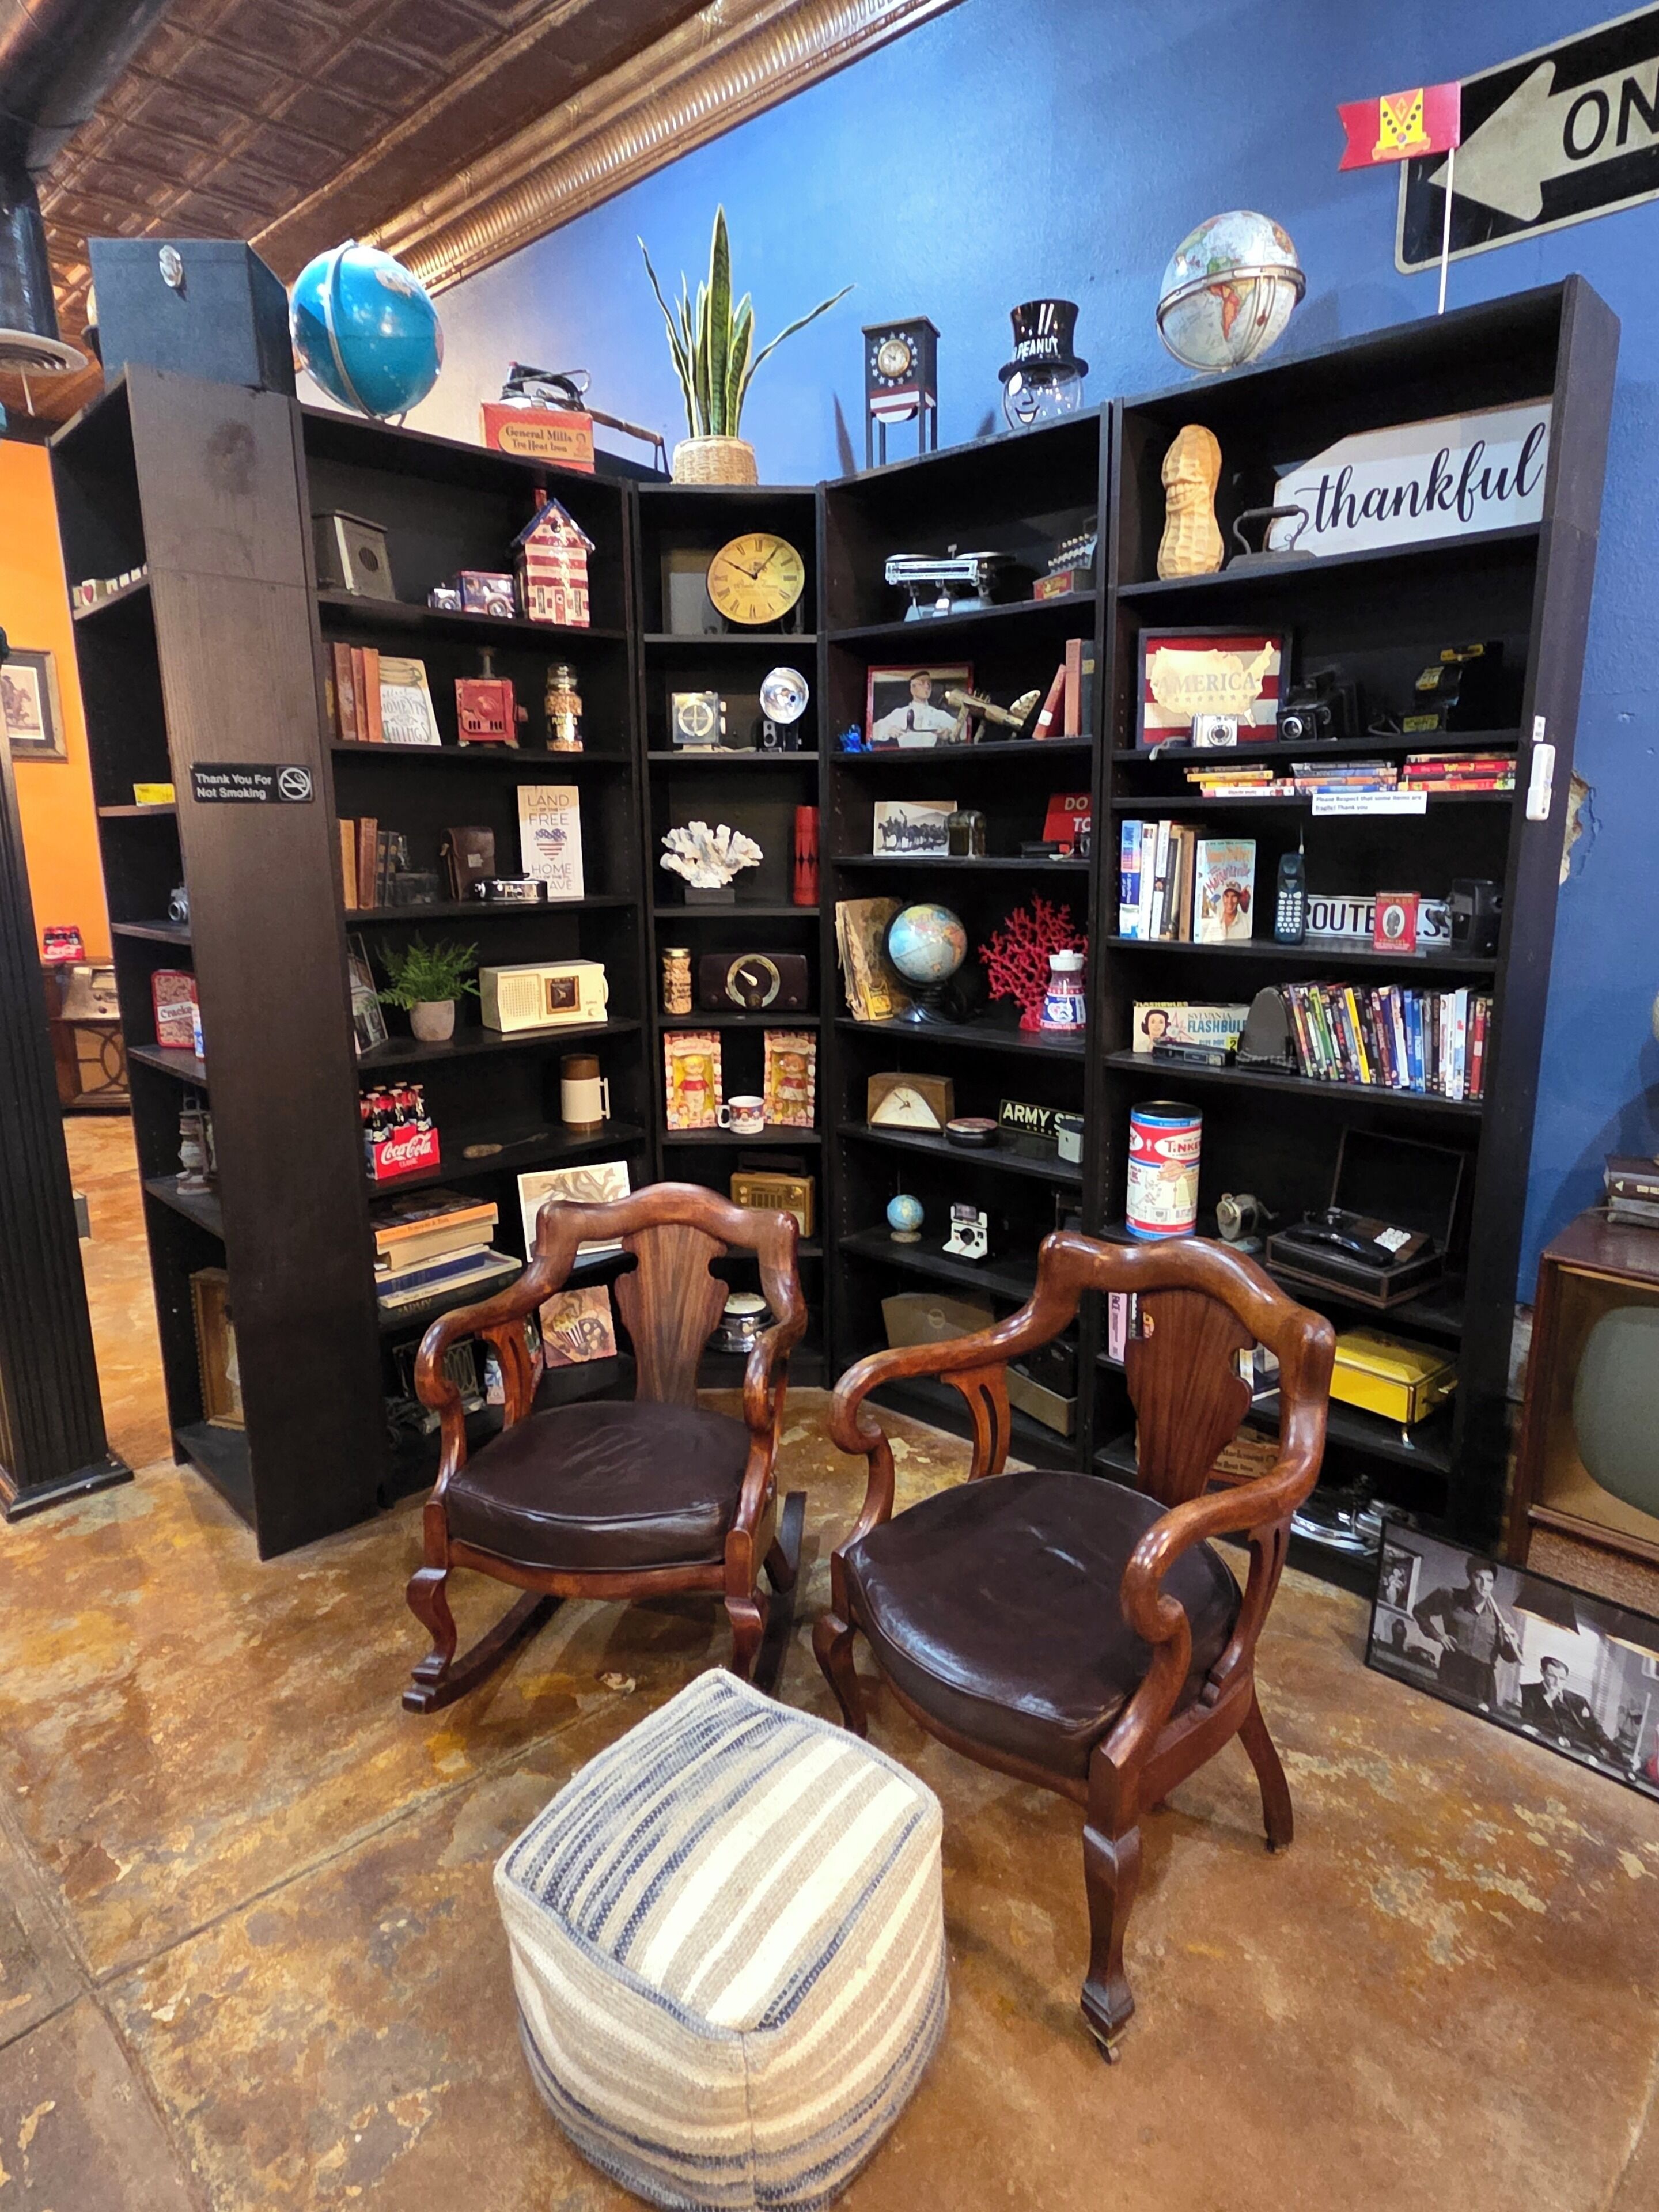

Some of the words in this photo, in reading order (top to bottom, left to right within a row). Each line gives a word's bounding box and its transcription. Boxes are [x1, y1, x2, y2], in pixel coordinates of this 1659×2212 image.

[1017, 335, 1059, 361] PEANUT
[505, 425, 544, 440] General
[547, 429, 573, 443] Mills
[528, 440, 548, 451] Heat
[1294, 422, 1547, 534] thankful
[1157, 672, 1257, 695] AMERICA
[195, 772, 230, 784] Thank
[232, 774, 252, 785] You
[254, 774, 272, 785] For
[196, 787, 217, 798] Not
[219, 787, 267, 800] Smoking
[527, 794, 570, 807] LAND
[1064, 797, 1088, 811] DO
[529, 812, 570, 826] FREE
[531, 863, 572, 874] HOME
[549, 879, 573, 891] AVE
[1188, 1020, 1247, 1033] FLASHBUL
[1003, 1103, 1050, 1126] ARMY
